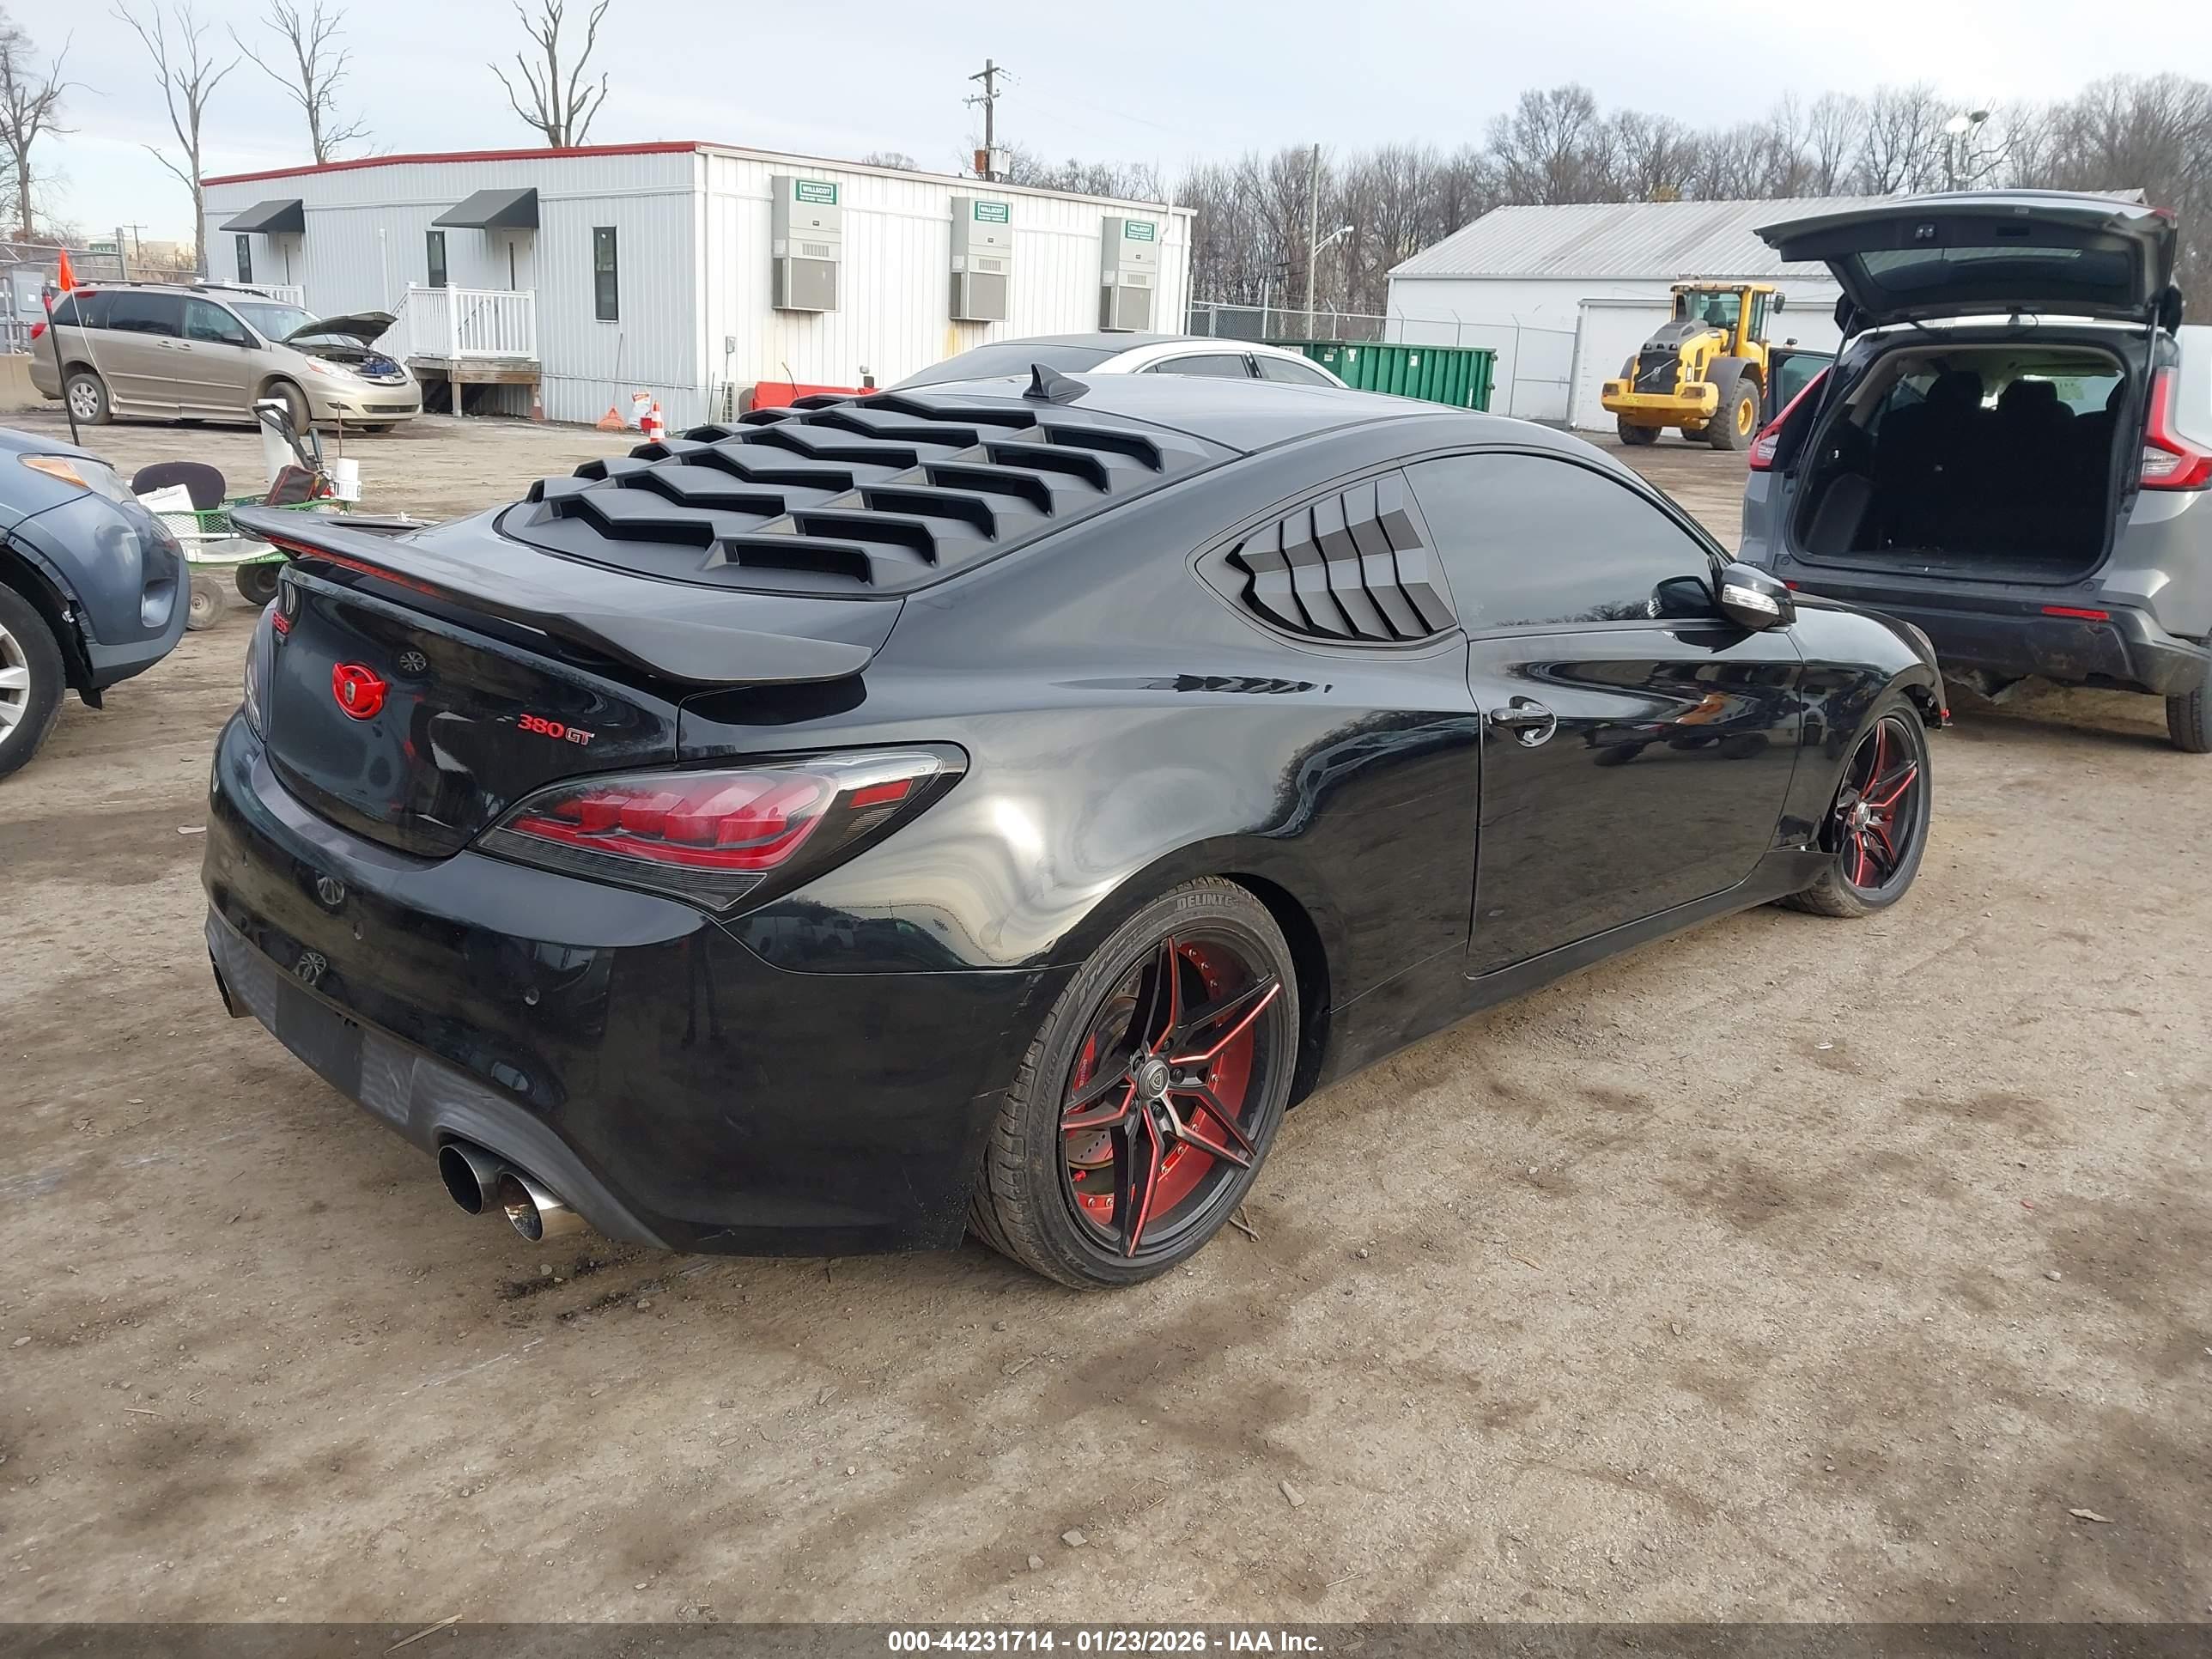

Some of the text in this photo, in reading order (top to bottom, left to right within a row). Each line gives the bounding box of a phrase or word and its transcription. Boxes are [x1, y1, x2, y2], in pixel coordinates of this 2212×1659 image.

[802, 185, 831, 196] WILLSCOT
[980, 206, 1003, 215] WILLSCOT
[1175, 893, 1231, 911] DELINTE
